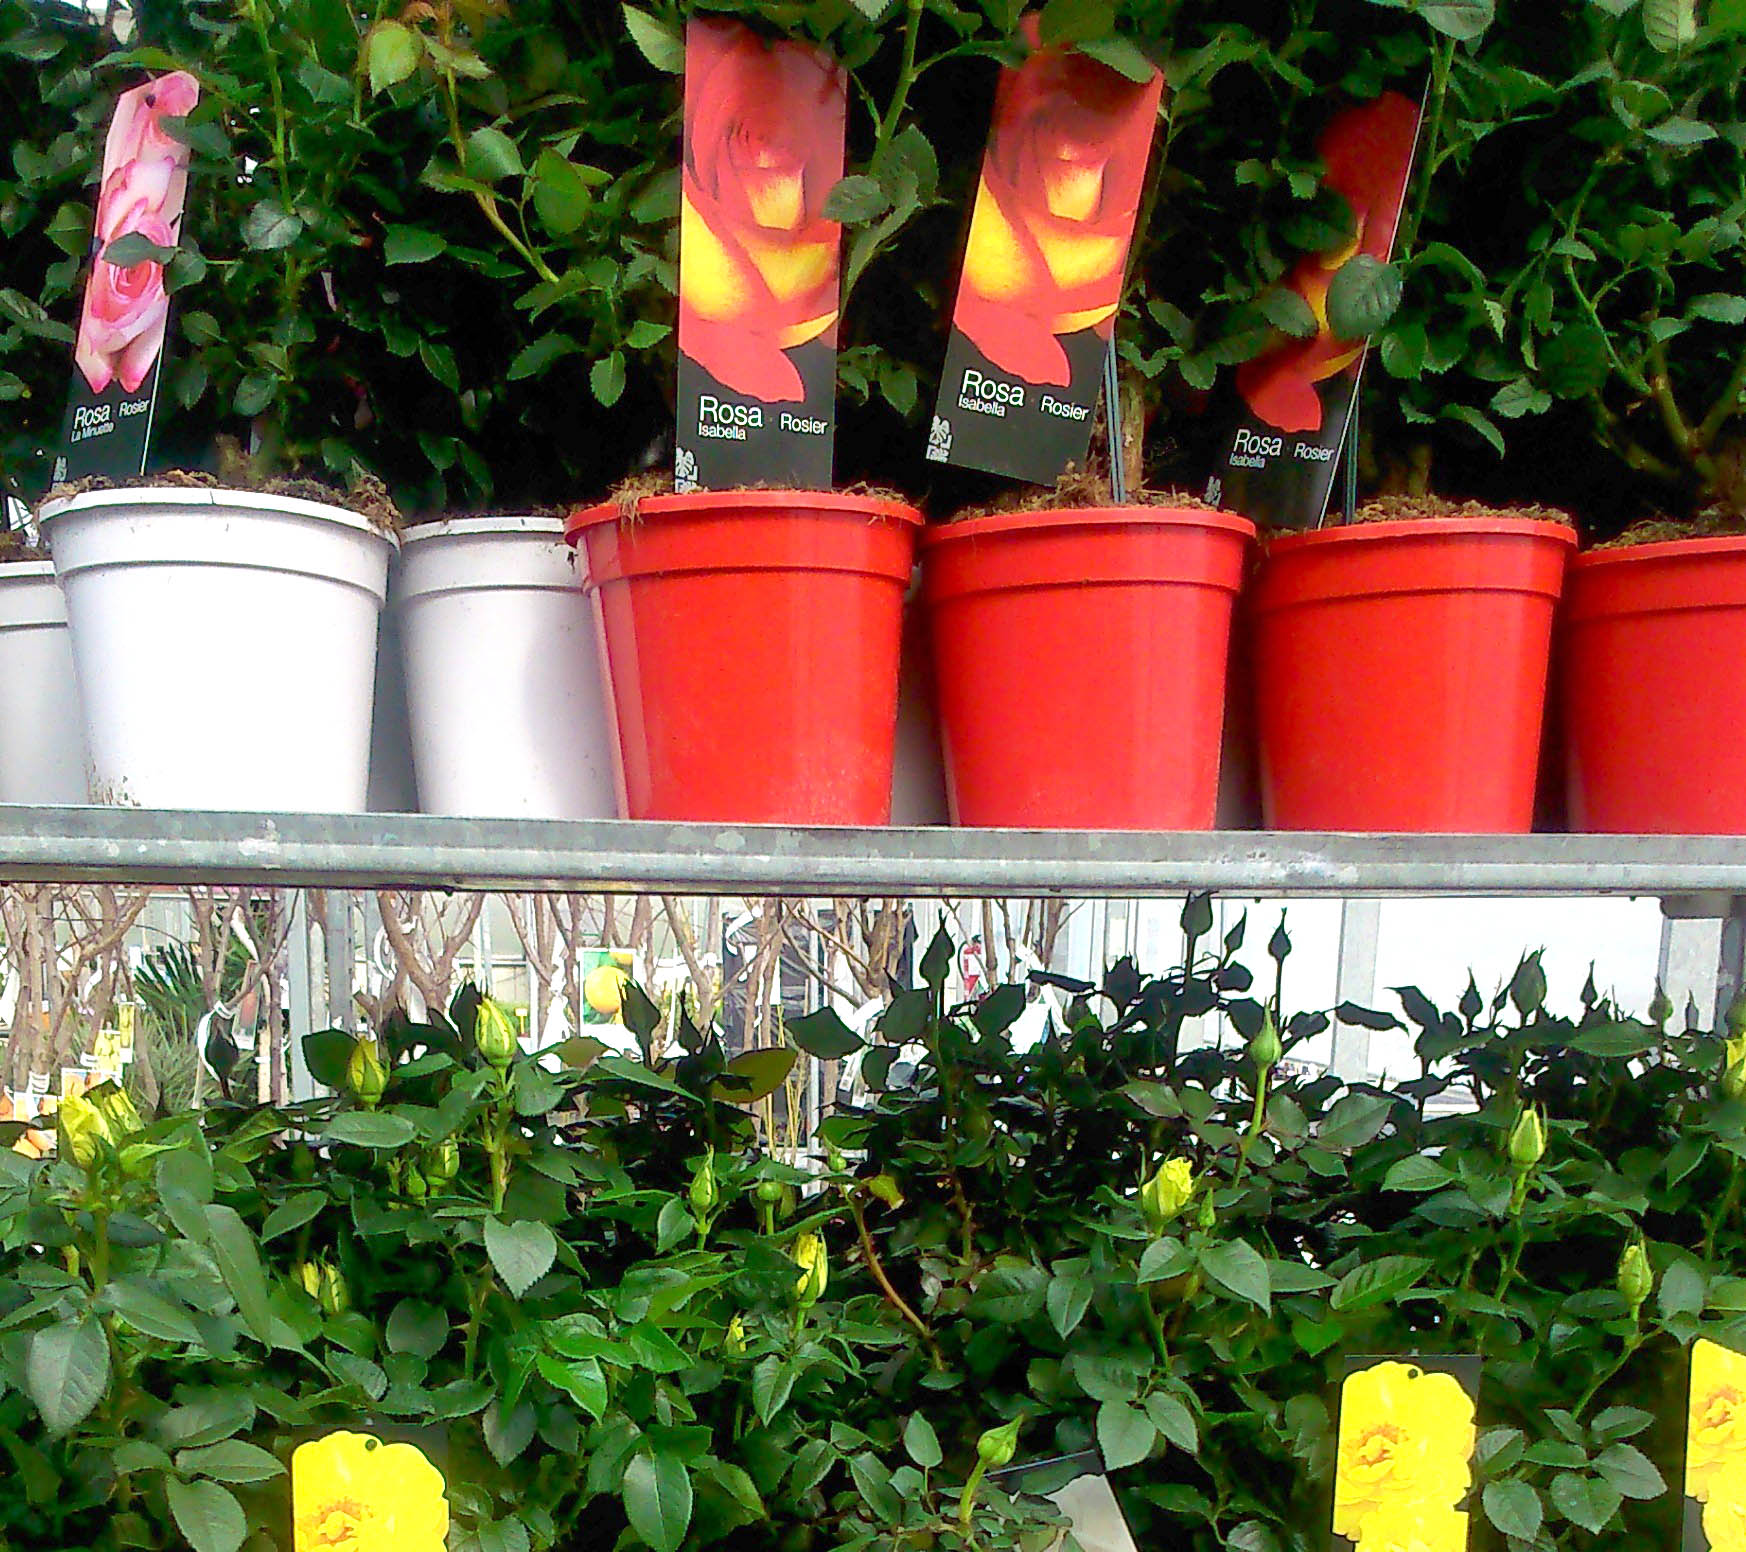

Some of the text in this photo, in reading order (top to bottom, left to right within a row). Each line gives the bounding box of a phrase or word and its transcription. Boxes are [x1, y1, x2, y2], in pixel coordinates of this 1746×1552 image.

[957, 394, 1006, 418] Isabella
[961, 369, 1090, 421] Rosa Rosier
[74, 398, 150, 430] Rosa Rosier
[699, 395, 829, 435] Rosa Rosier
[698, 422, 747, 441] Isabella
[1233, 428, 1335, 462] Rosa Rosier
[1229, 452, 1266, 469] Isabella
